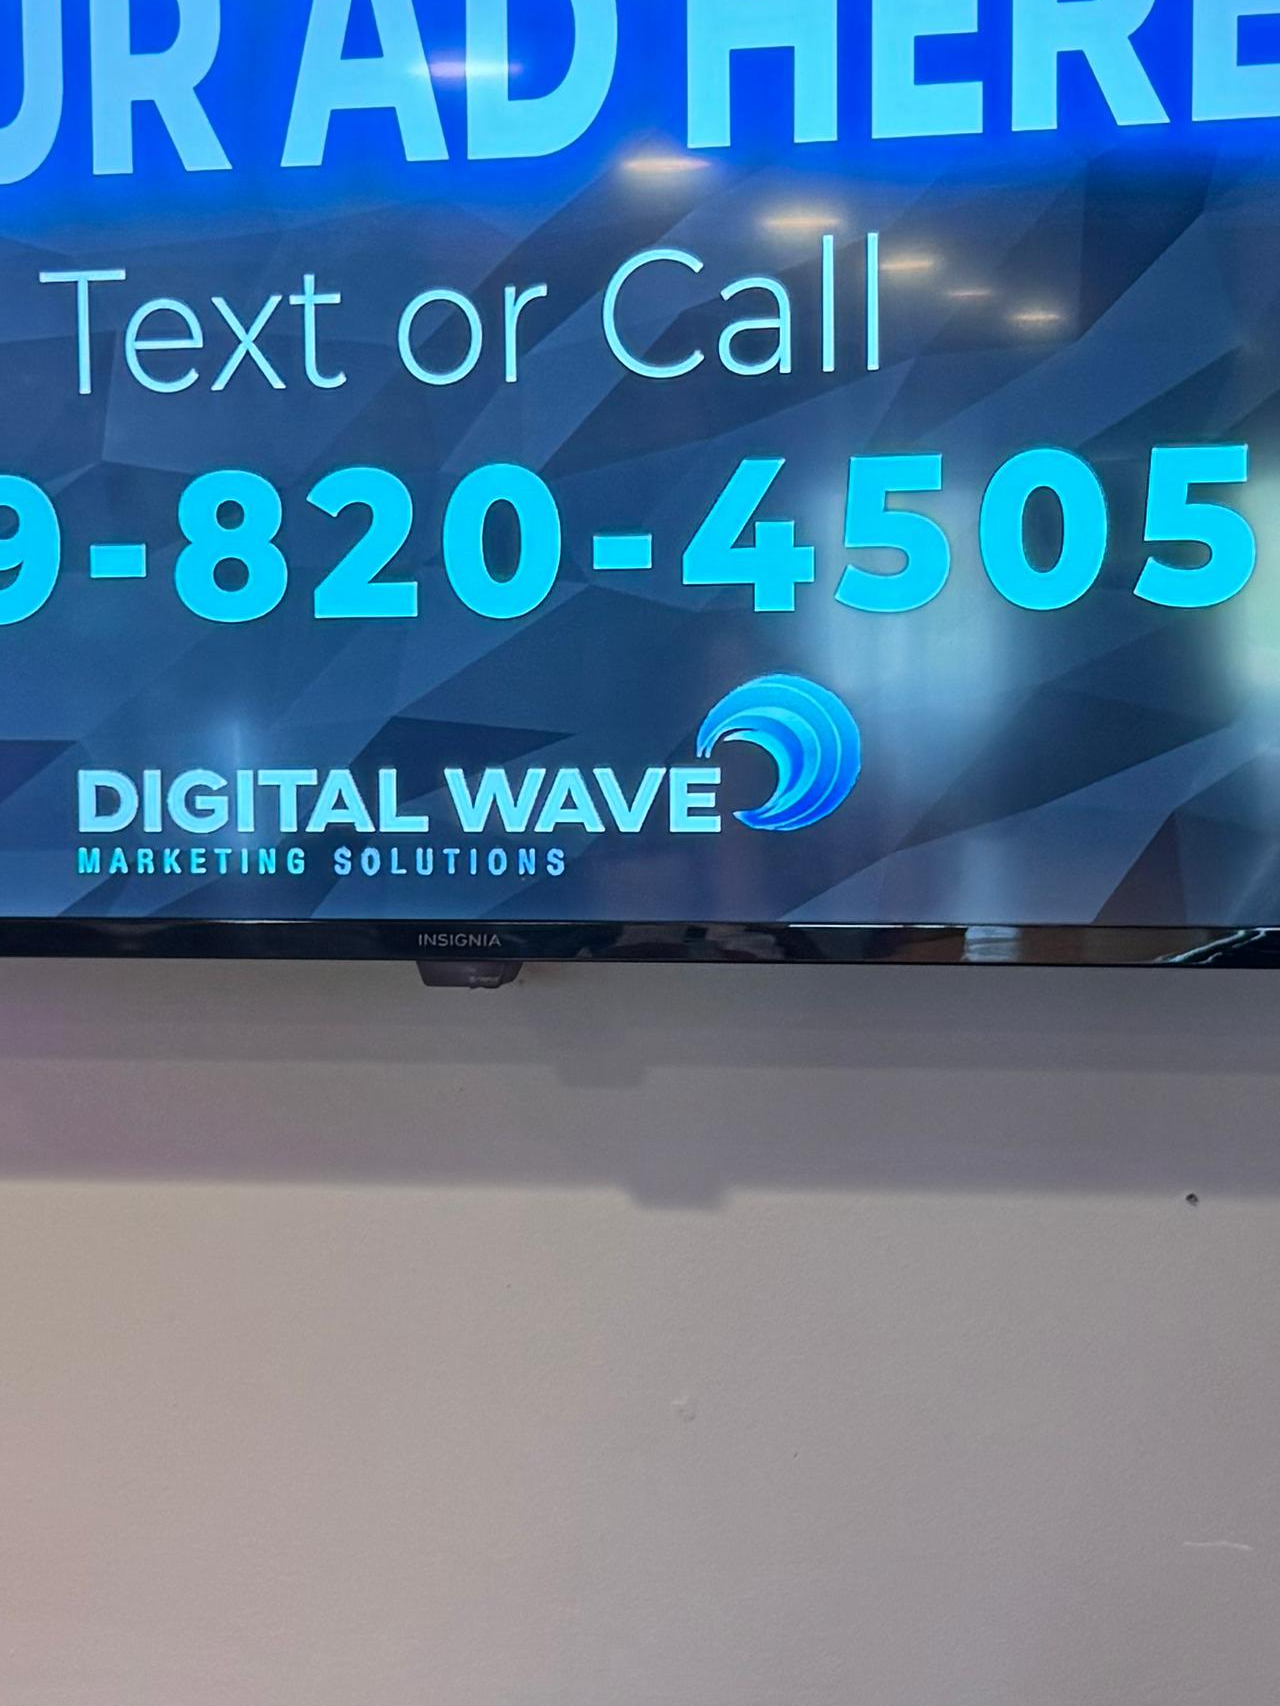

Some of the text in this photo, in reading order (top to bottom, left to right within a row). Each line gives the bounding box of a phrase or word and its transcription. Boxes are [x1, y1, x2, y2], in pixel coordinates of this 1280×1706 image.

[39, 231, 879, 395] Text or Call
[77, 766, 722, 834] DIGITAL WAVE
[77, 846, 566, 877] MARKETING SOLUTIONS
[418, 933, 502, 947] INSIGNIA
